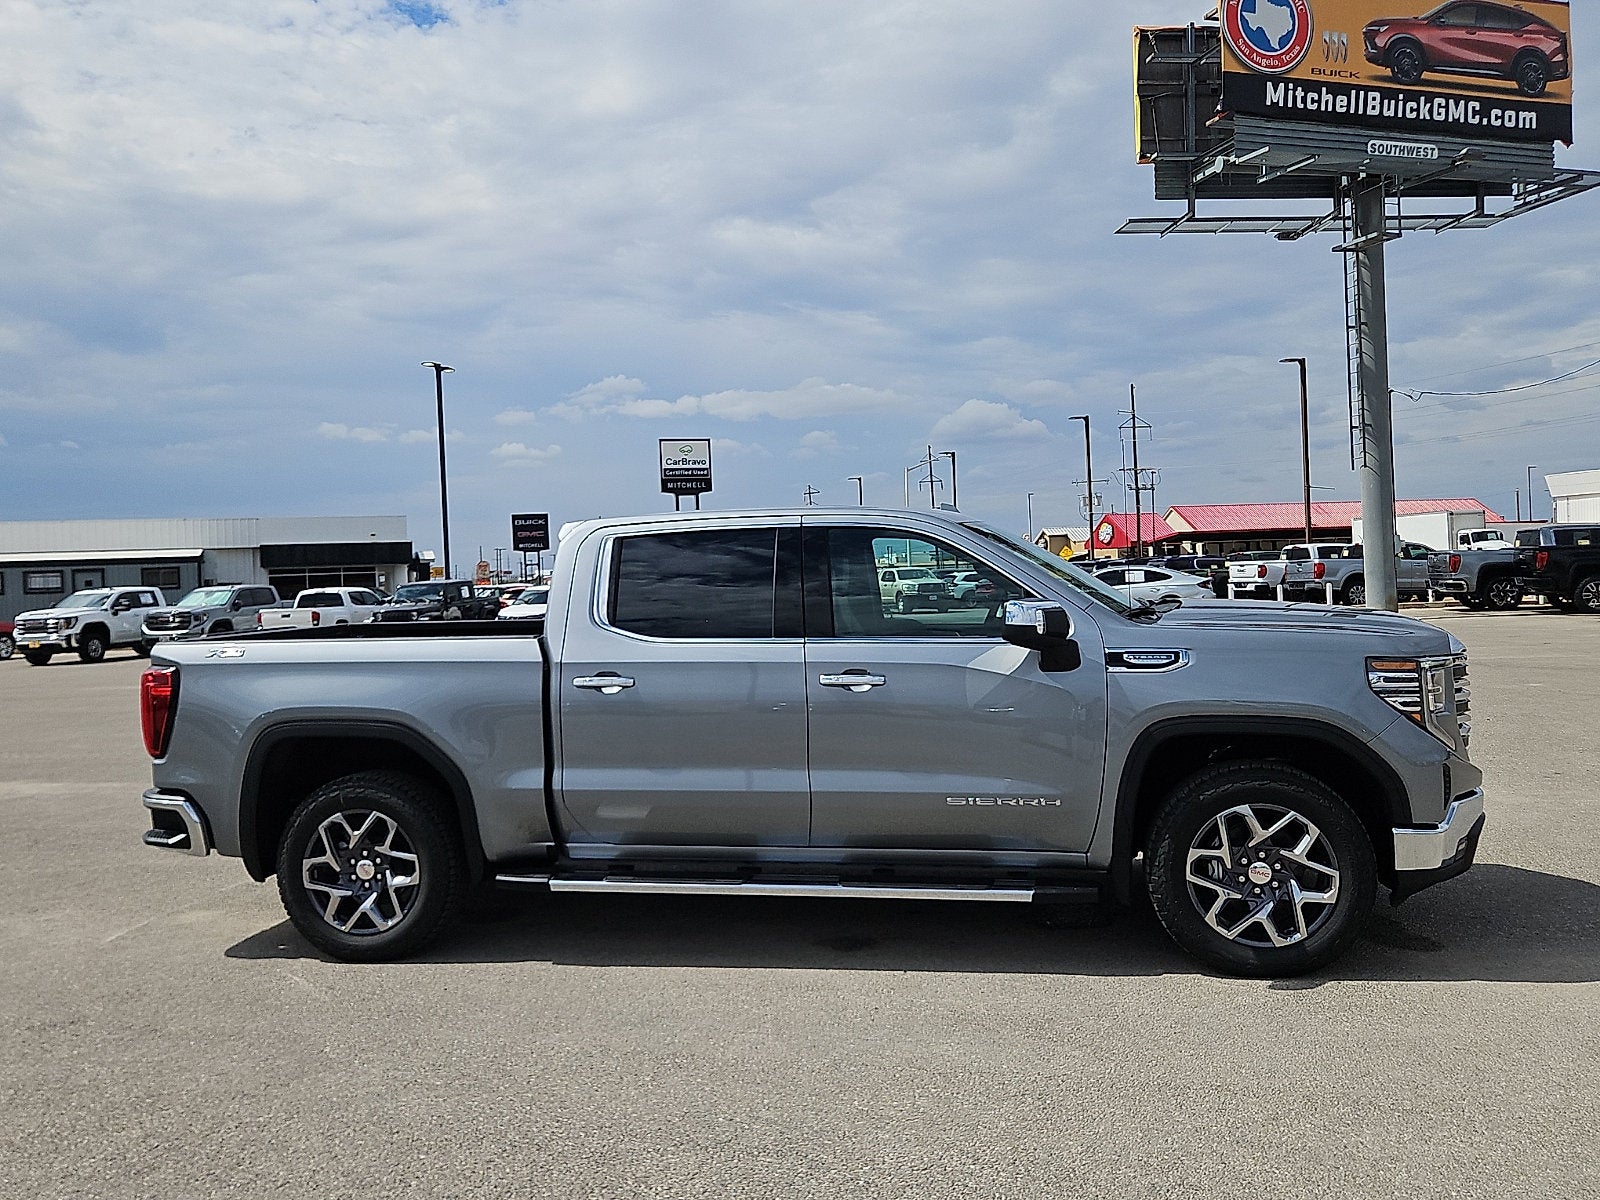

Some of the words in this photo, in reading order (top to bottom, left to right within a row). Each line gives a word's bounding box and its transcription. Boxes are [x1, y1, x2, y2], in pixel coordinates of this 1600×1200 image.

[1236, 38, 1250, 56] San
[1250, 53, 1281, 67] Angelo,
[1281, 44, 1301, 64] Texas
[1310, 67, 1360, 79] BUICK
[1265, 81, 1537, 129] MitchellBuickGMC.com
[1369, 142, 1436, 159] SOUTHWEST
[665, 457, 707, 466] CarBravo
[667, 481, 707, 489] MITCHELL
[514, 518, 546, 526] BUICK
[517, 530, 545, 538] GMC
[945, 796, 1063, 807] SIERRA
[1250, 868, 1270, 878] GMC
